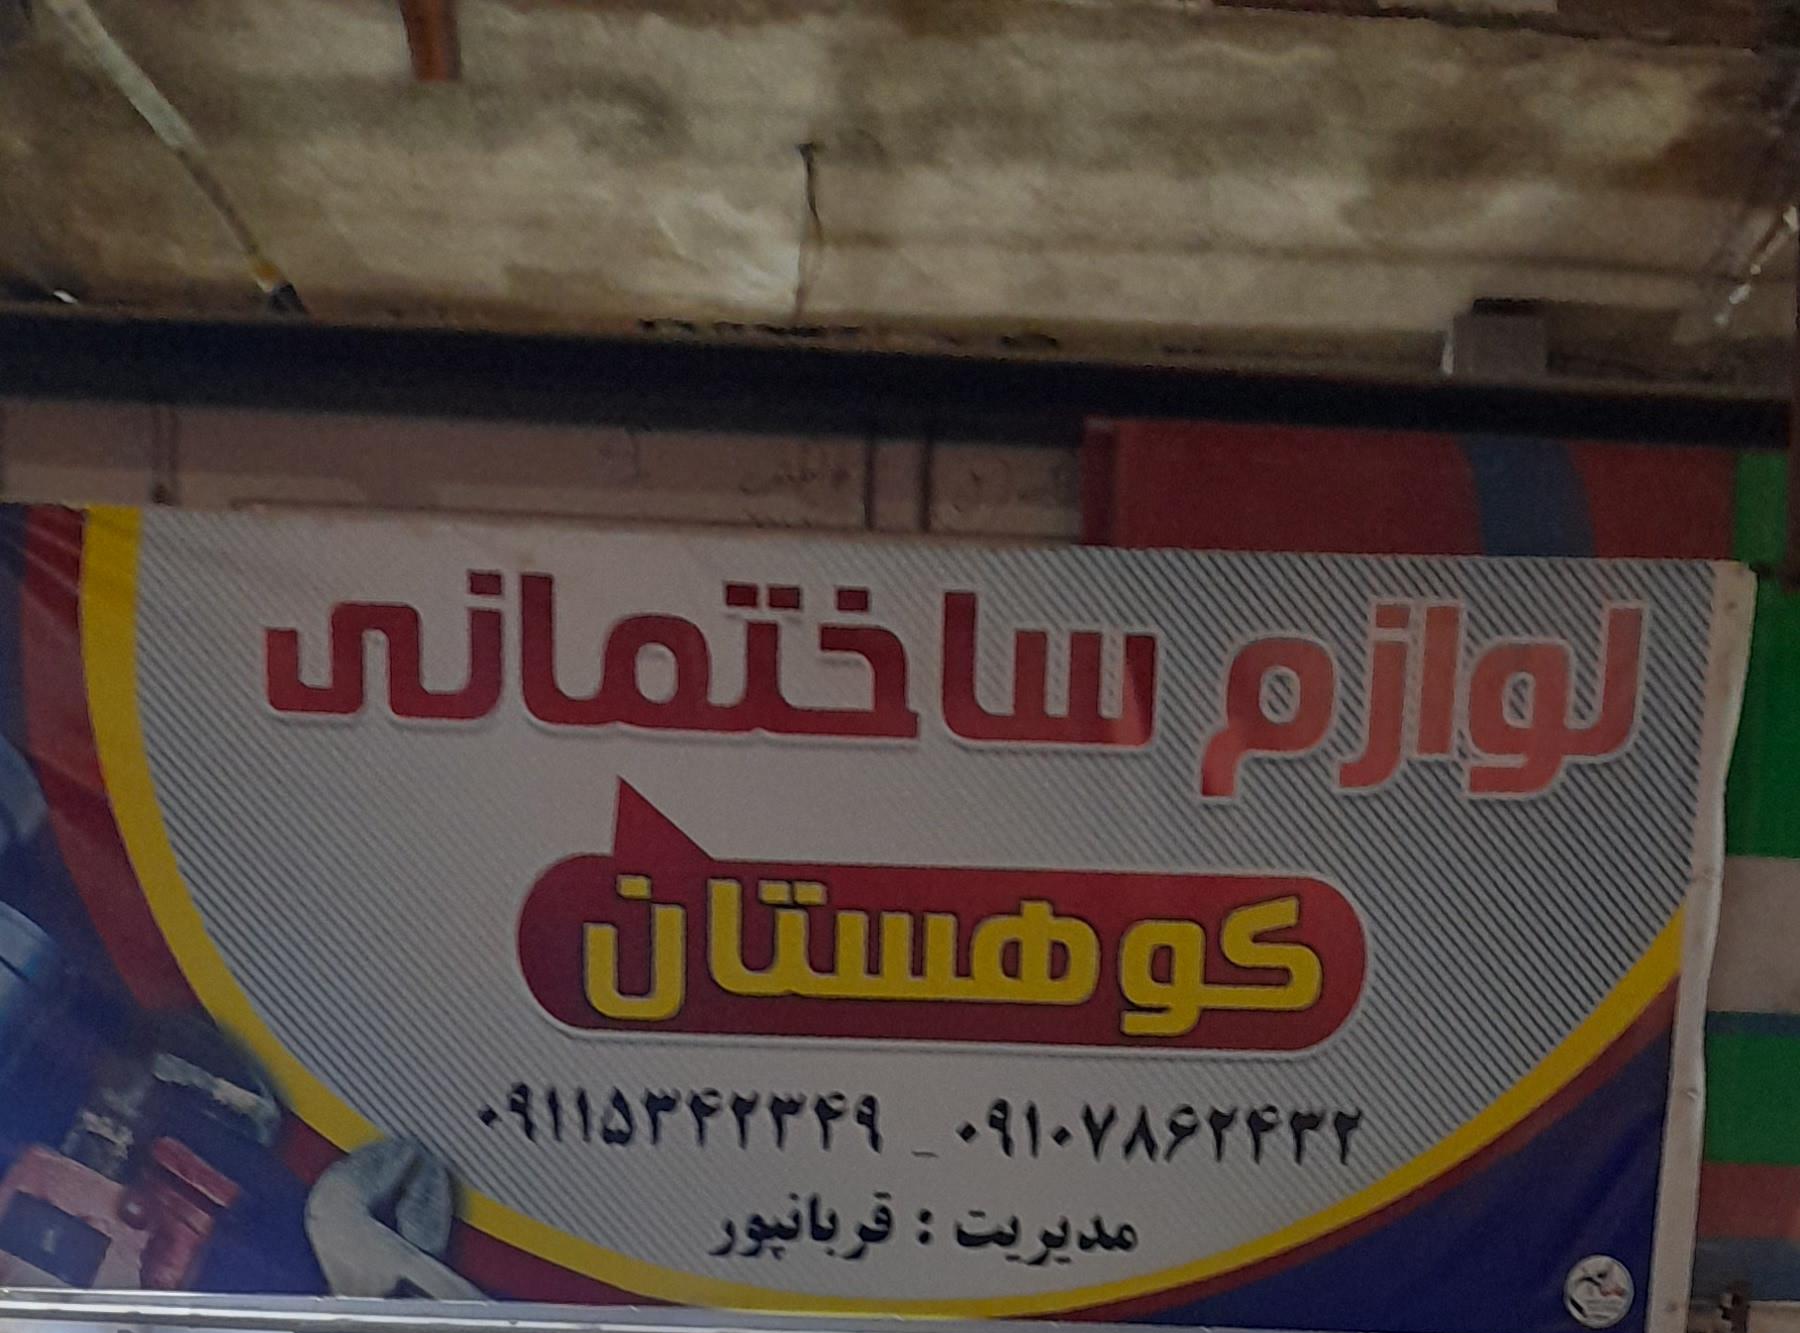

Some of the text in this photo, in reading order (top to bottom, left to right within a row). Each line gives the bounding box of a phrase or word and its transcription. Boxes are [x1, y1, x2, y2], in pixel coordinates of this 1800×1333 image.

[264, 570, 1644, 796] لوازم ساختمانی
[582, 872, 1326, 1036] کوهستان
[477, 1081, 884, 1154] ۰۹۱۱۵۳۴۲۳۴۹
[955, 1097, 1363, 1167] ۰۹۱۰۷۸۶۲۴۳۲
[707, 1190, 894, 1261] قربانپور
[955, 1209, 1139, 1267] مدیریت
